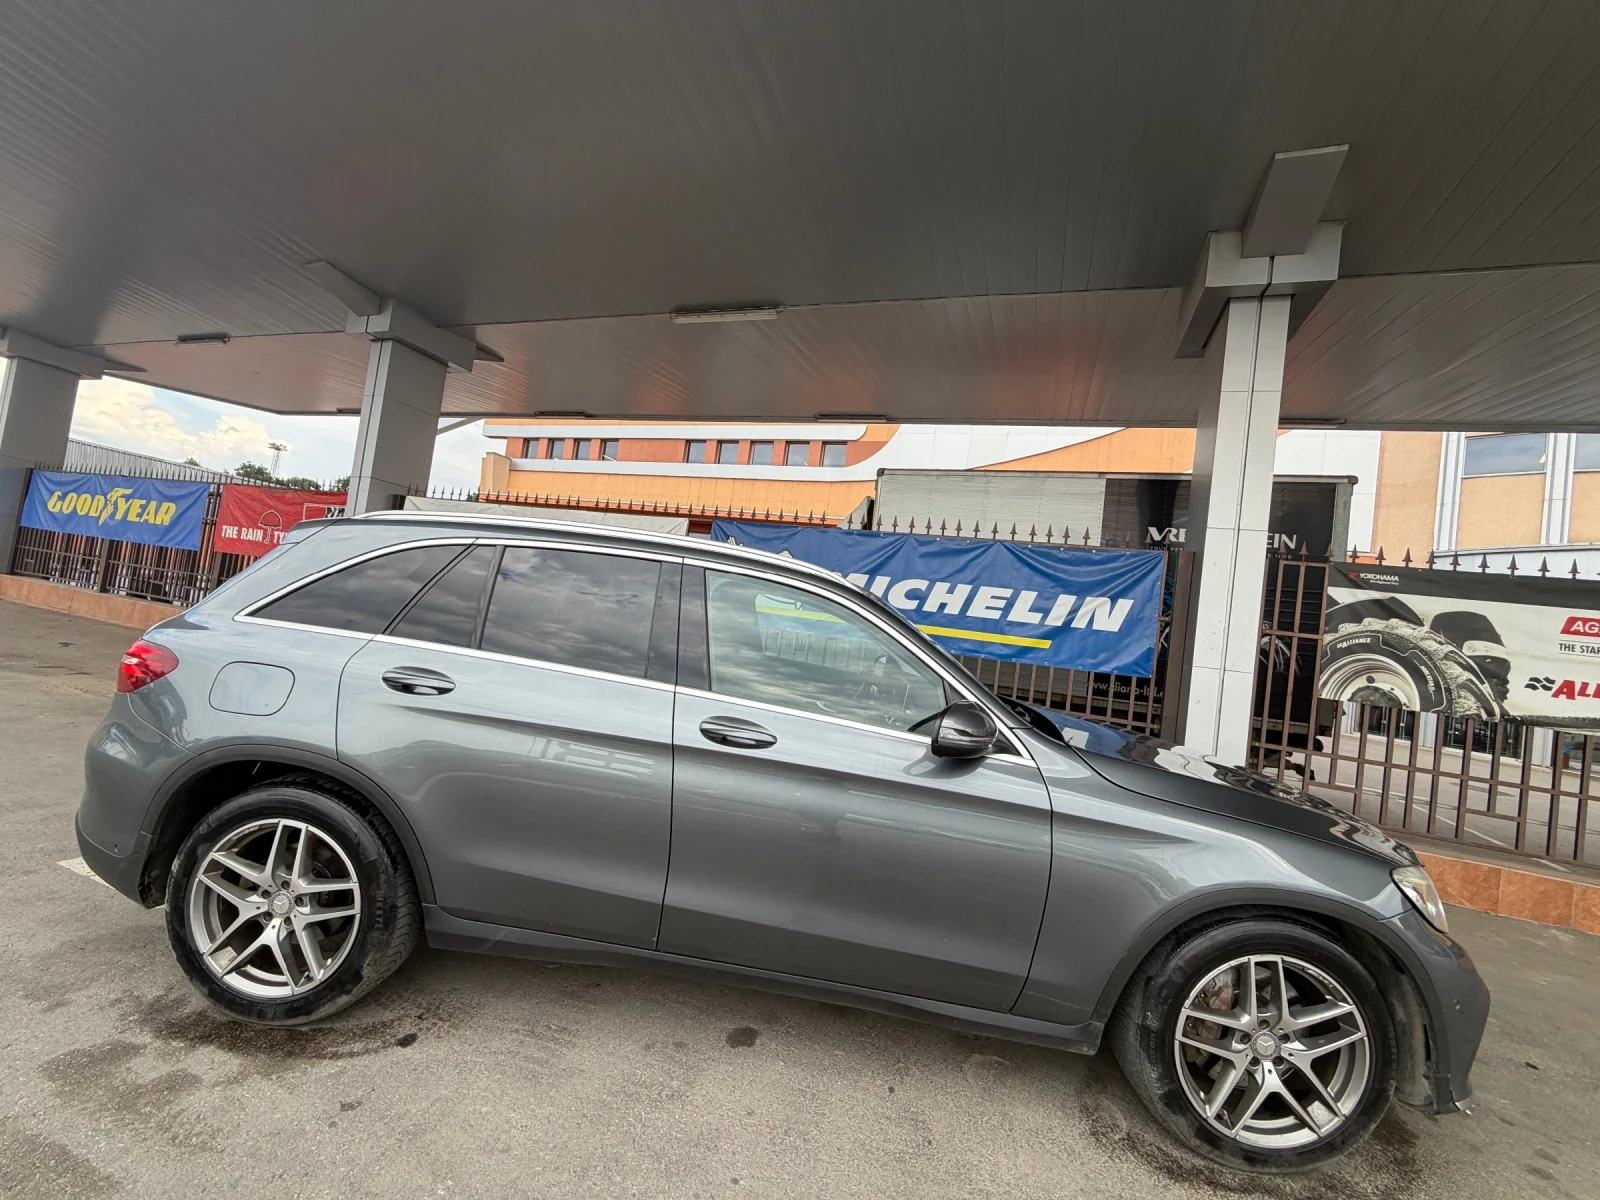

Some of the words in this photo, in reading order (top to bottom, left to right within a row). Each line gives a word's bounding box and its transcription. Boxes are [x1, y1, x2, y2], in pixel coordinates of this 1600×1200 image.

[47, 489, 176, 526] GOODYEAR
[221, 525, 239, 539] THE
[241, 527, 263, 541] RAIN
[273, 530, 289, 544] TY
[1359, 573, 1399, 582] YOKOHAMA
[1569, 620, 1600, 634] AG
[1342, 637, 1371, 648] ALLIANCE
[1558, 643, 1577, 652] THE
